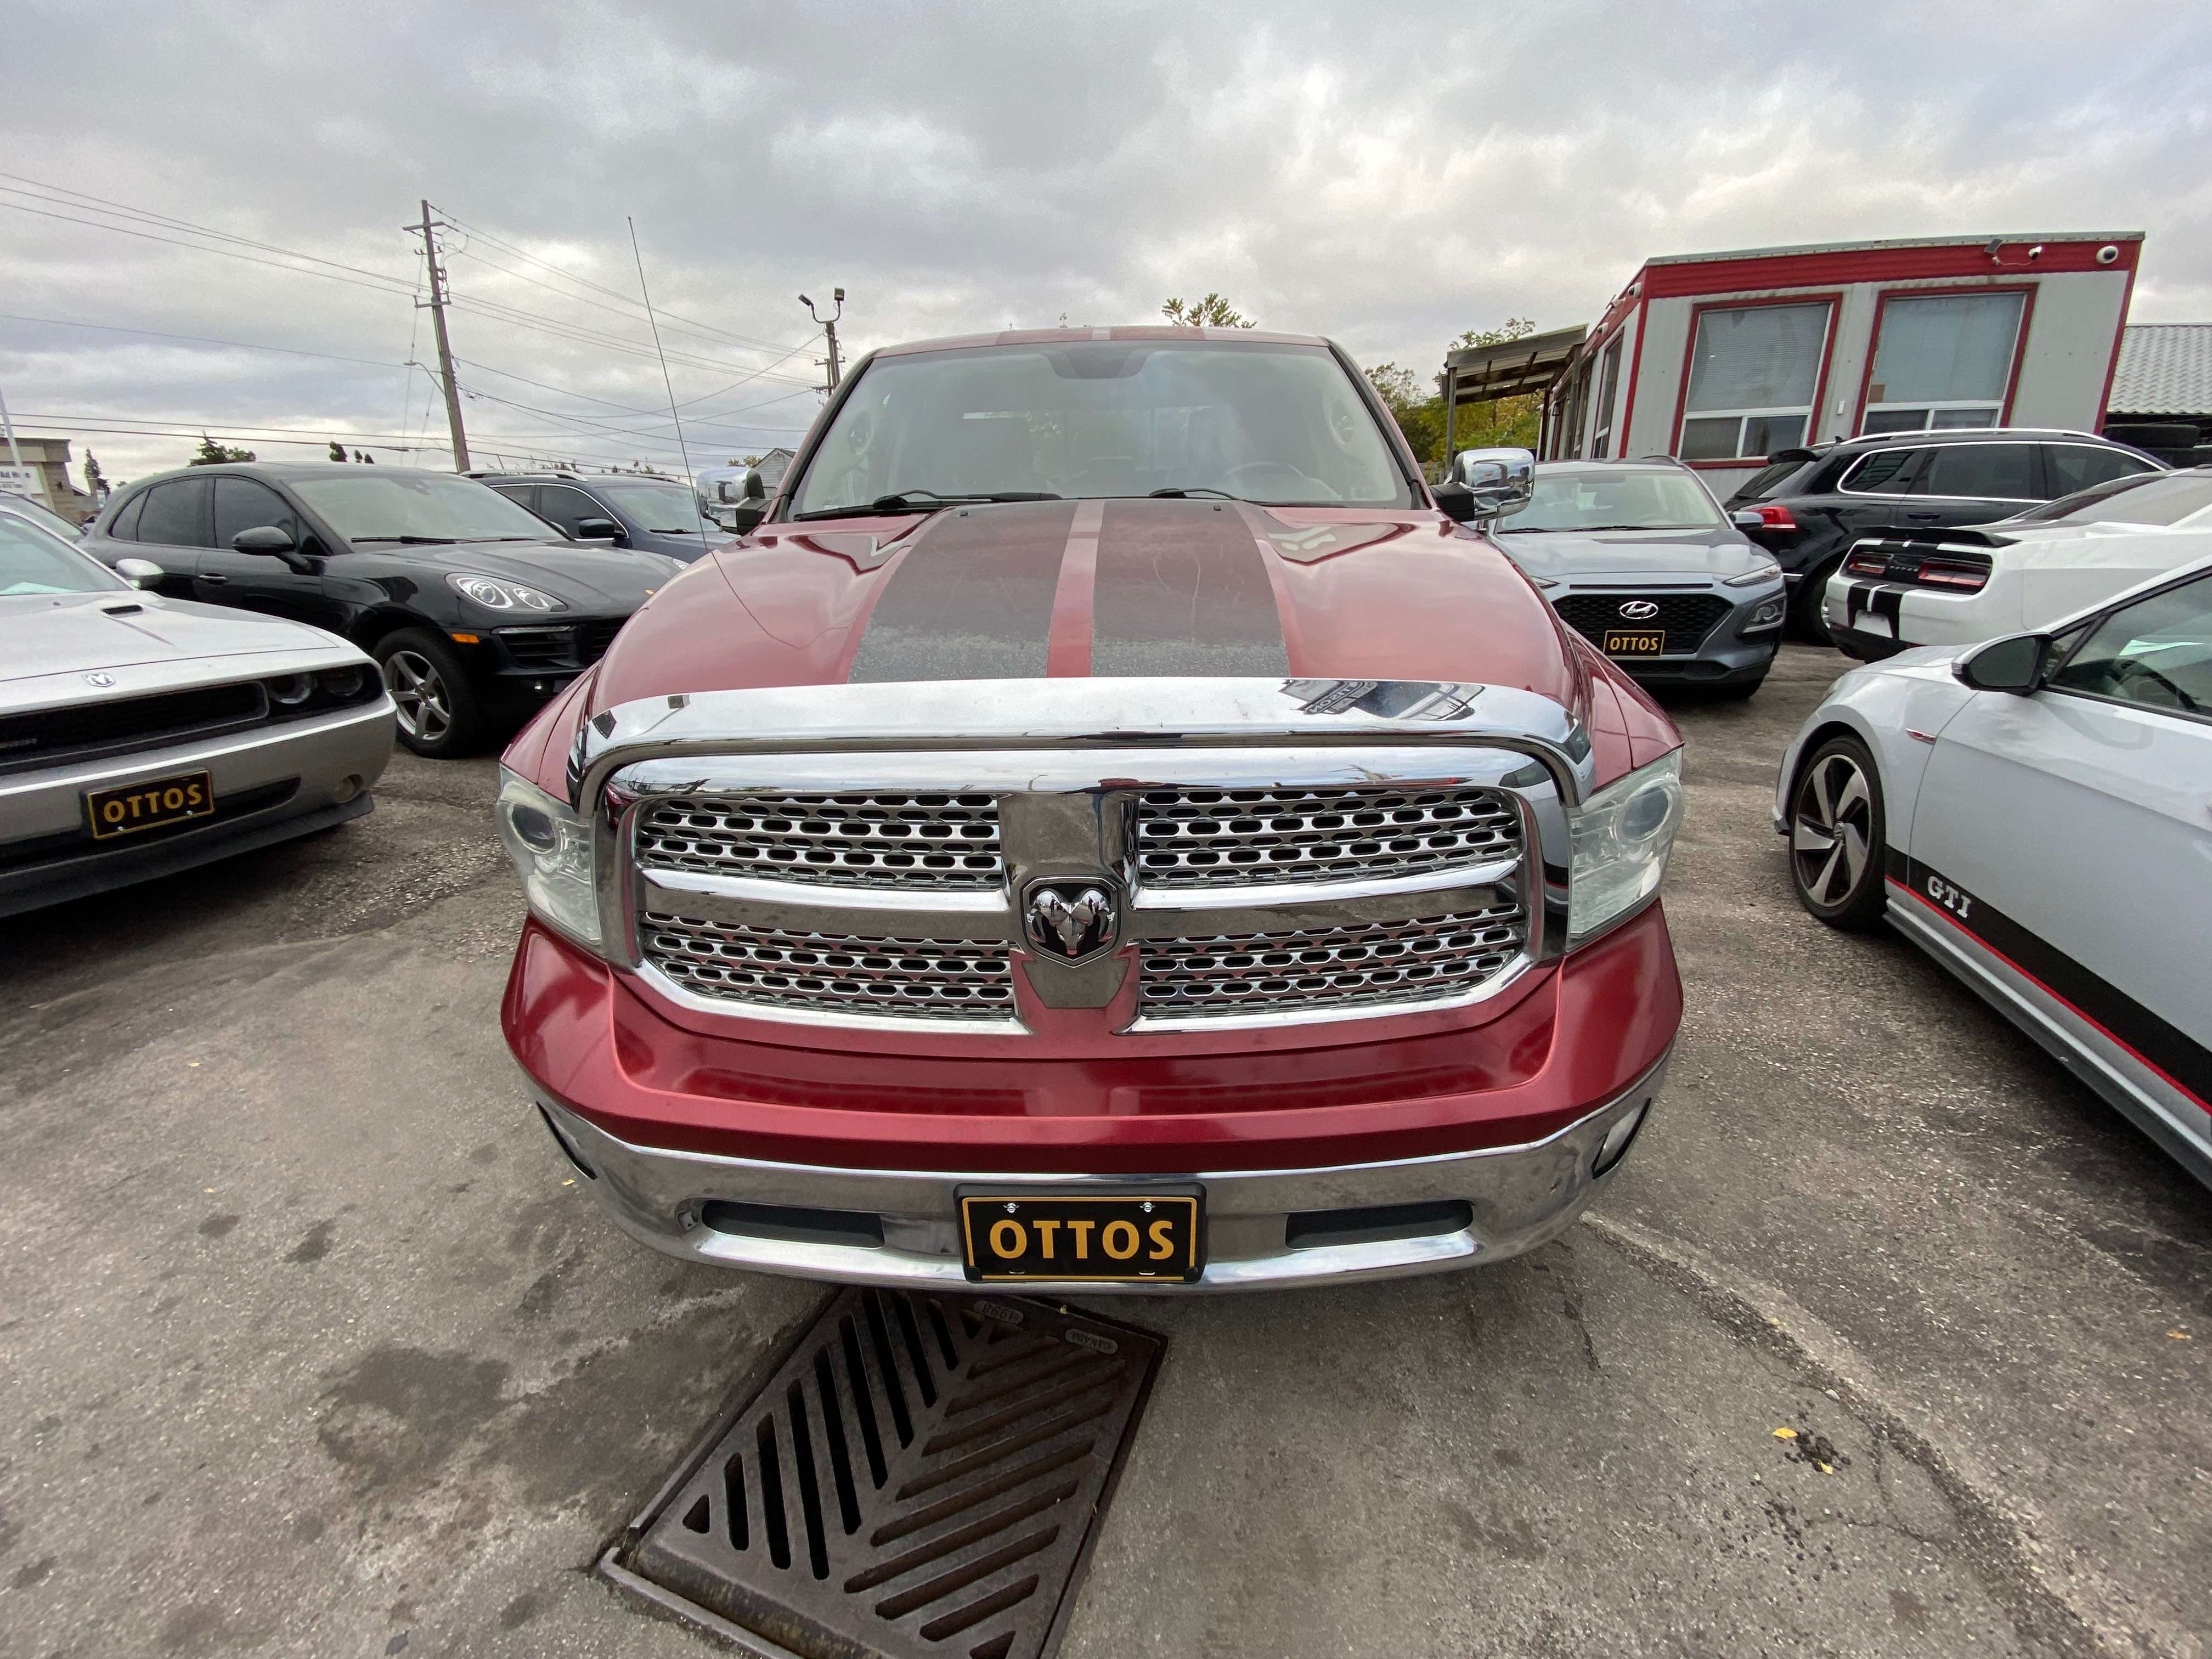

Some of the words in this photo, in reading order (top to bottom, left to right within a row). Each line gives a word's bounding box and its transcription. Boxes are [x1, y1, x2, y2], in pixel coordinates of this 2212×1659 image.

[1610, 637, 1658, 651] OTTOS
[103, 783, 202, 823] OTTOS
[1927, 875, 1971, 919] GTI
[989, 1220, 1175, 1260] OTTOS
